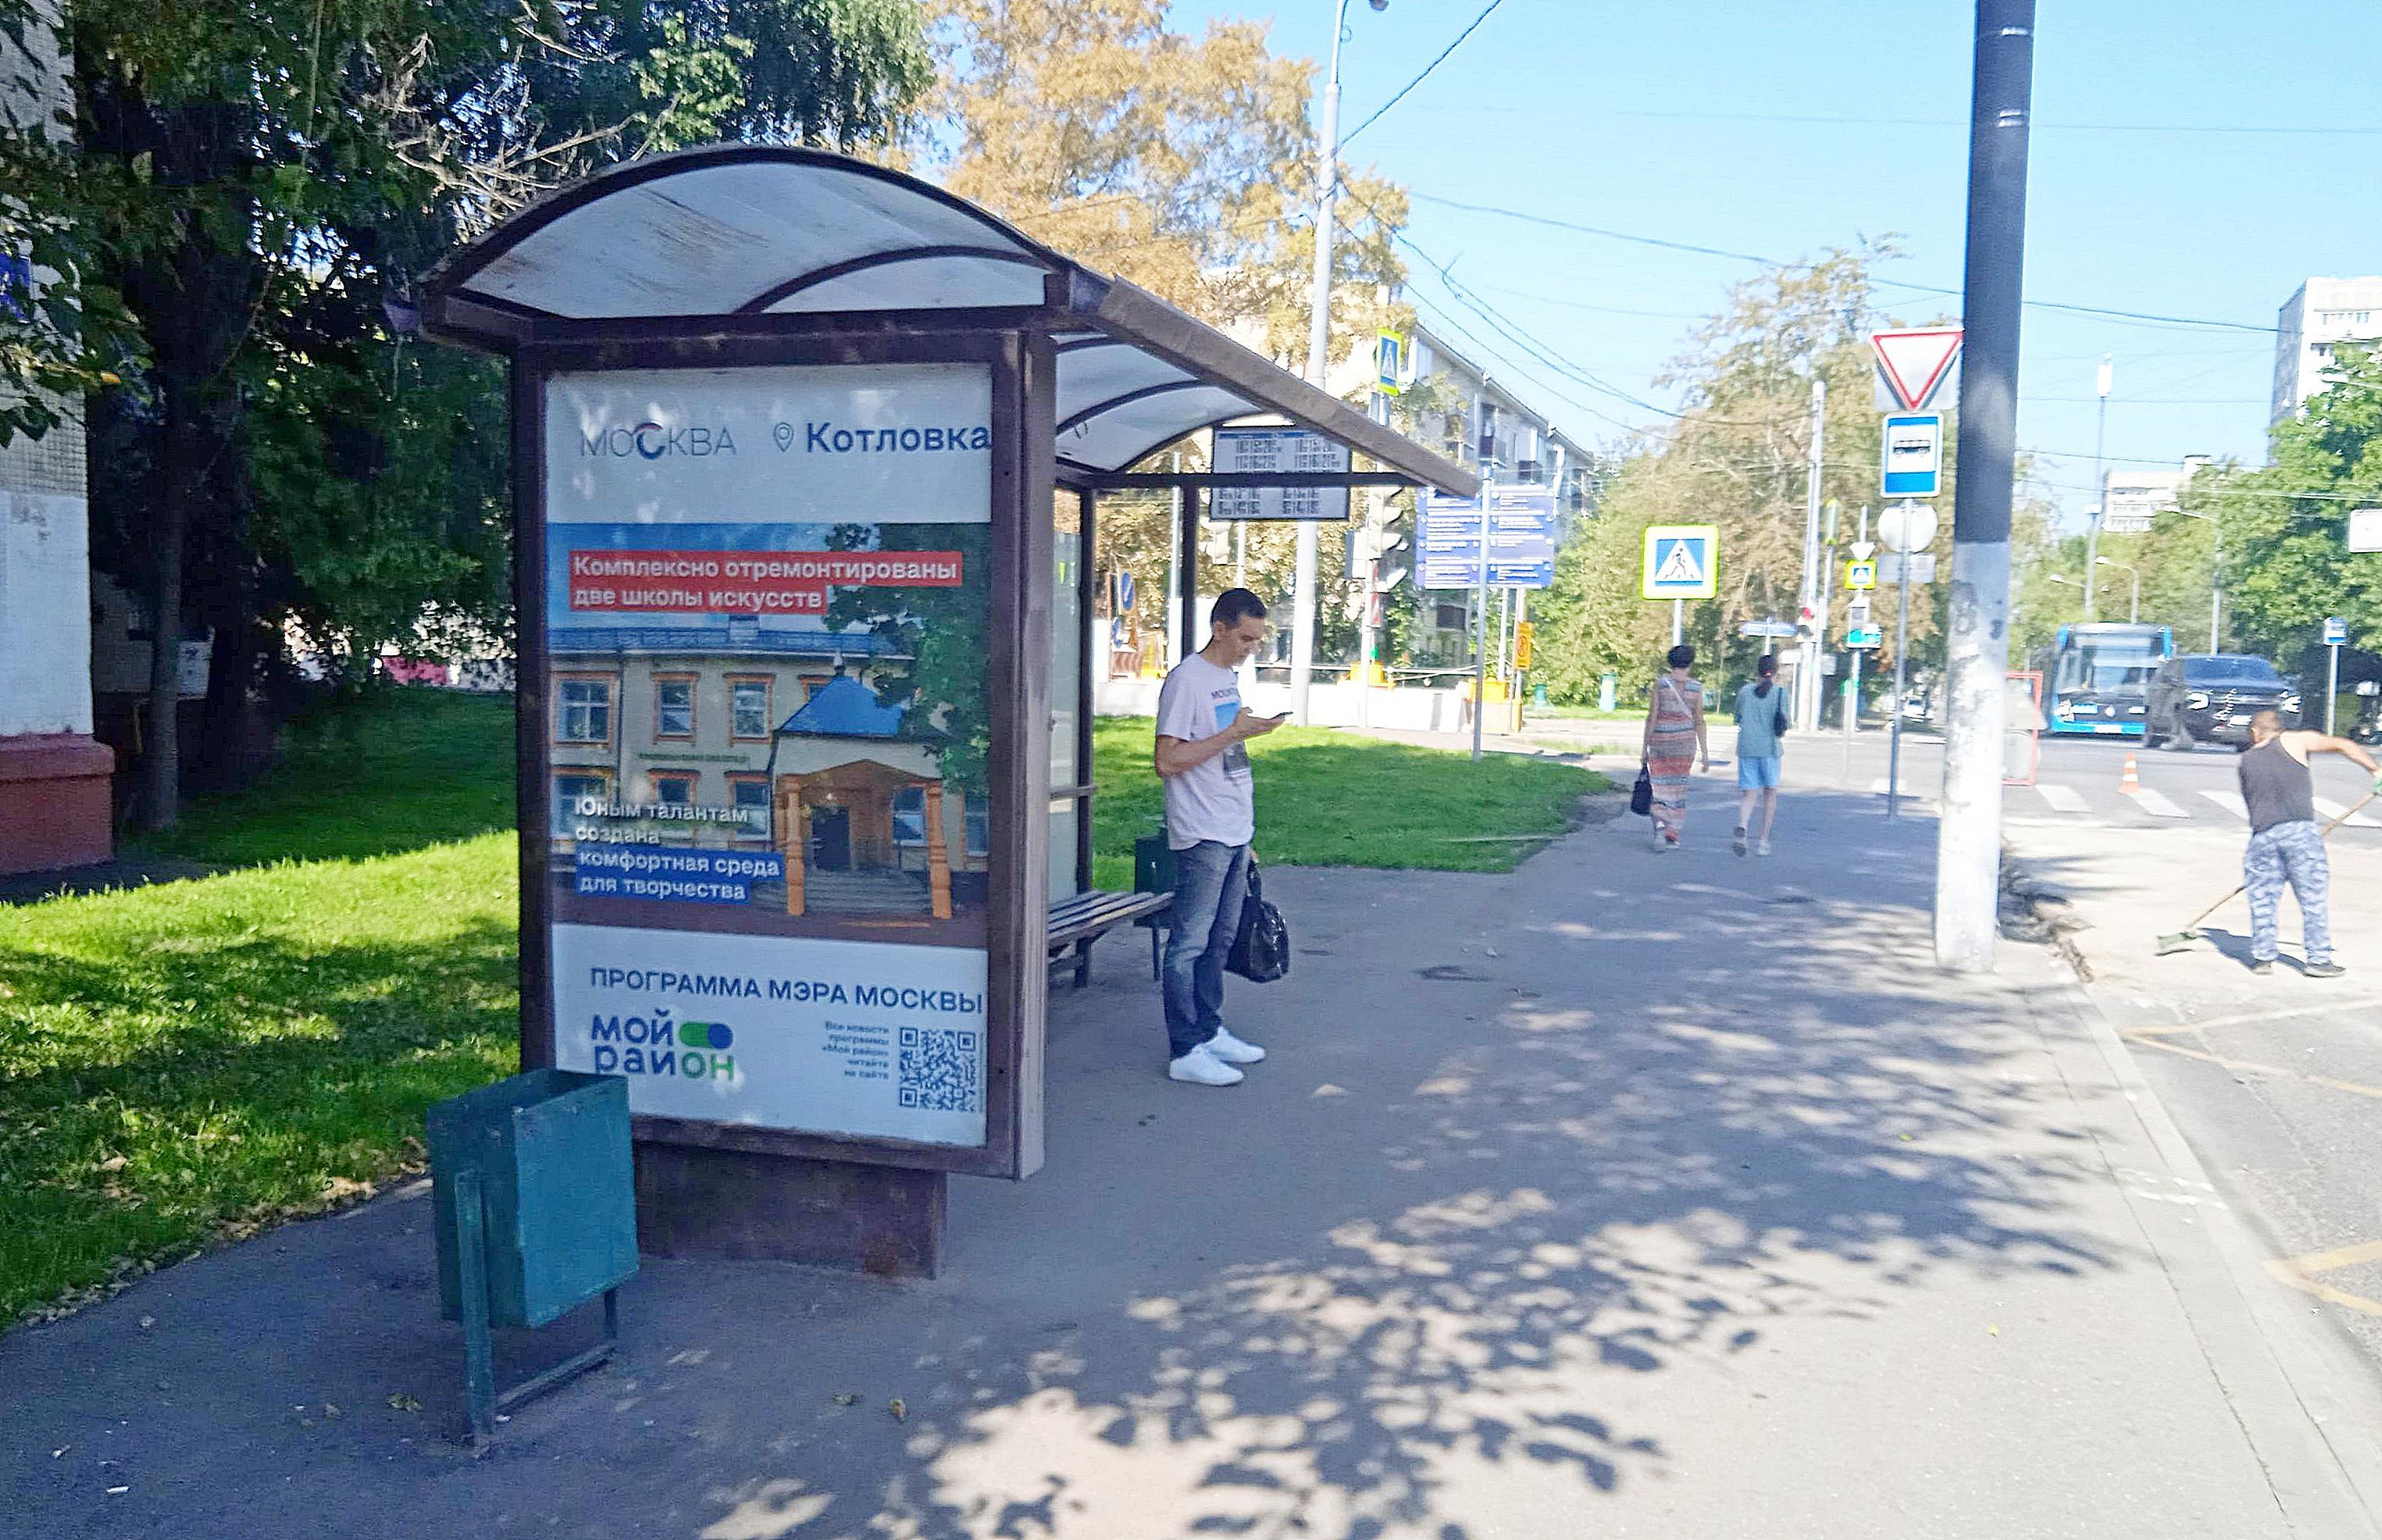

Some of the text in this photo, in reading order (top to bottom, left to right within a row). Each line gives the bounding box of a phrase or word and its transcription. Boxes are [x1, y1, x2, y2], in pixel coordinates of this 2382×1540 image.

[581, 422, 736, 460] МОСКВА
[807, 422, 991, 453] Котловка
[574, 556, 957, 583] Комплексно отремонтированы
[575, 590, 822, 612] две школы искусств
[575, 795, 748, 822] Юным талантам
[575, 825, 660, 844] создана
[579, 849, 779, 878] комфортная среда
[580, 876, 746, 900] для творчества
[590, 967, 982, 1014] ПРОГРАММА МЭРА МОСКВЫ
